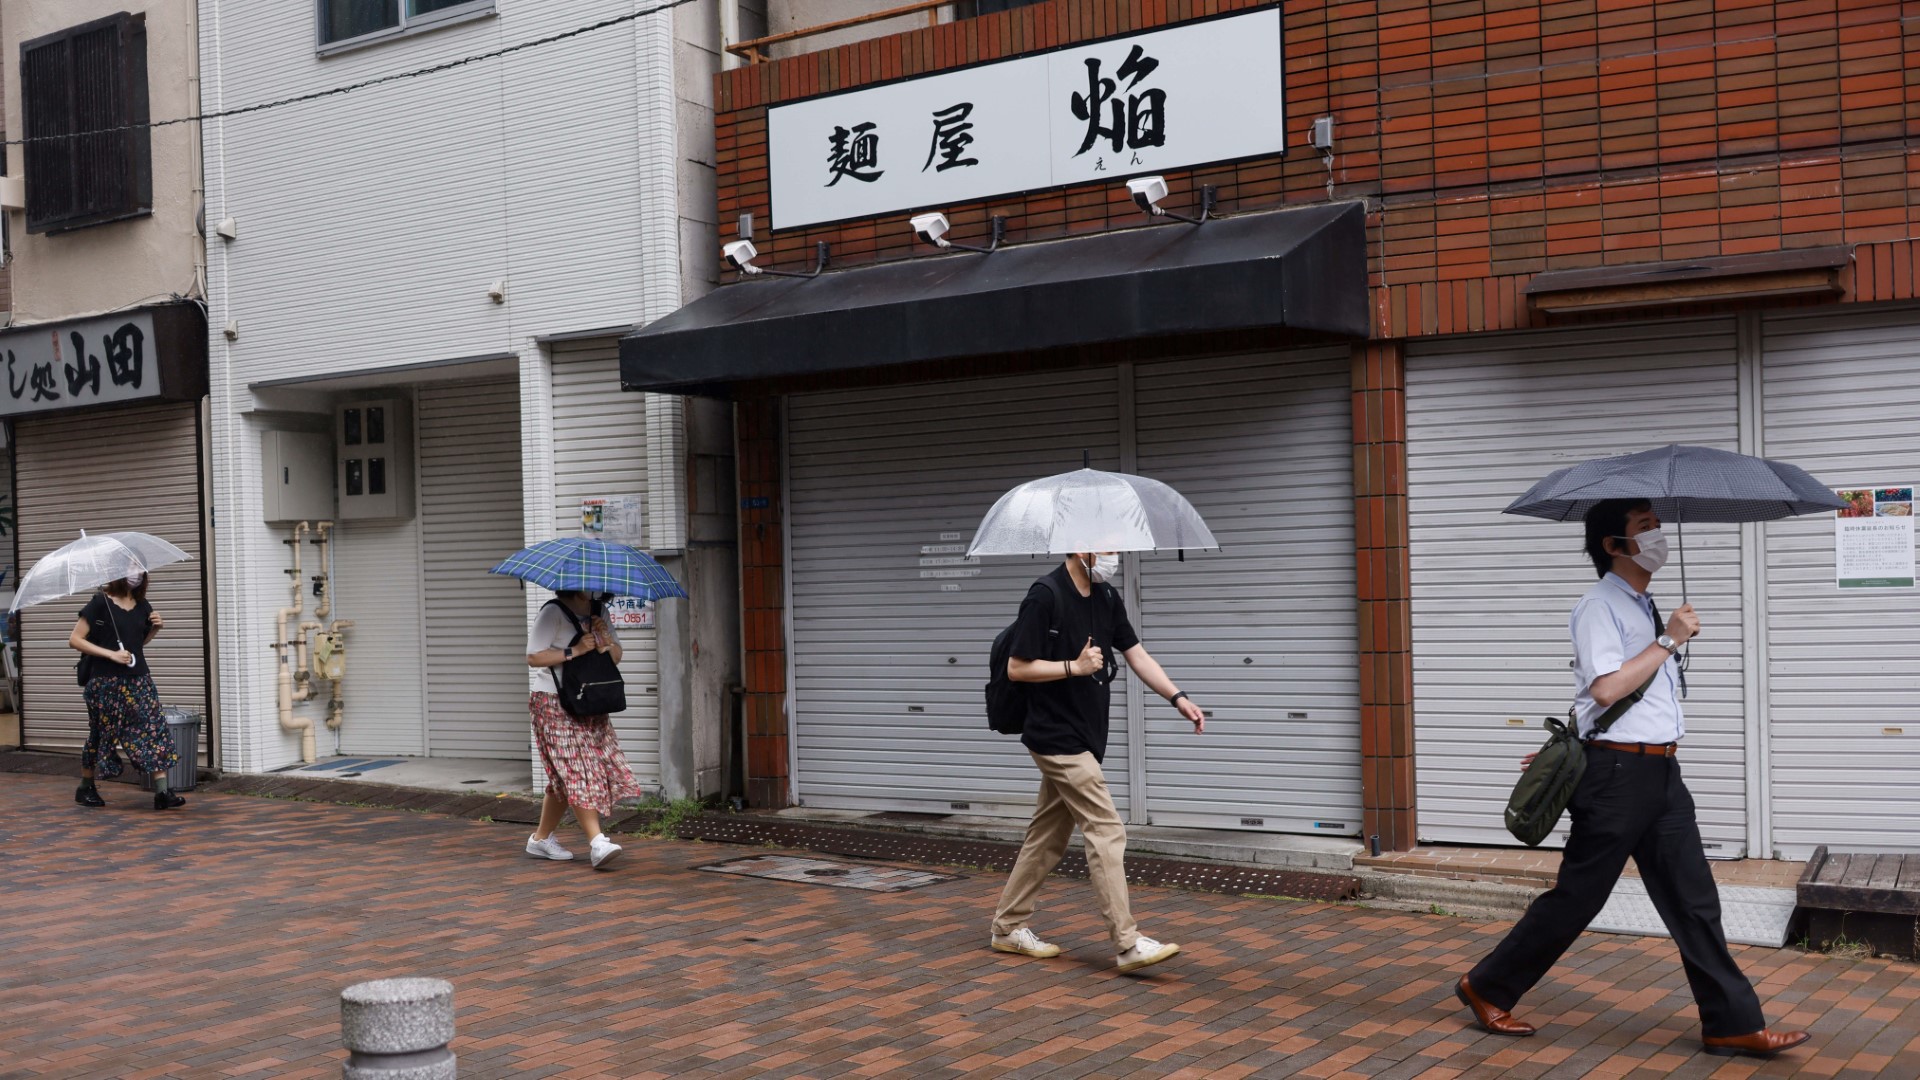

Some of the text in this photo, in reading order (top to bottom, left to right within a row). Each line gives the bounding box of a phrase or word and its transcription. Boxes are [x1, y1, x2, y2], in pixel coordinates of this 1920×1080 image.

[824, 44, 1167, 187] 麺屋 焔
[1094, 152, 1143, 171] えん
[0, 323, 144, 402] し処山田
